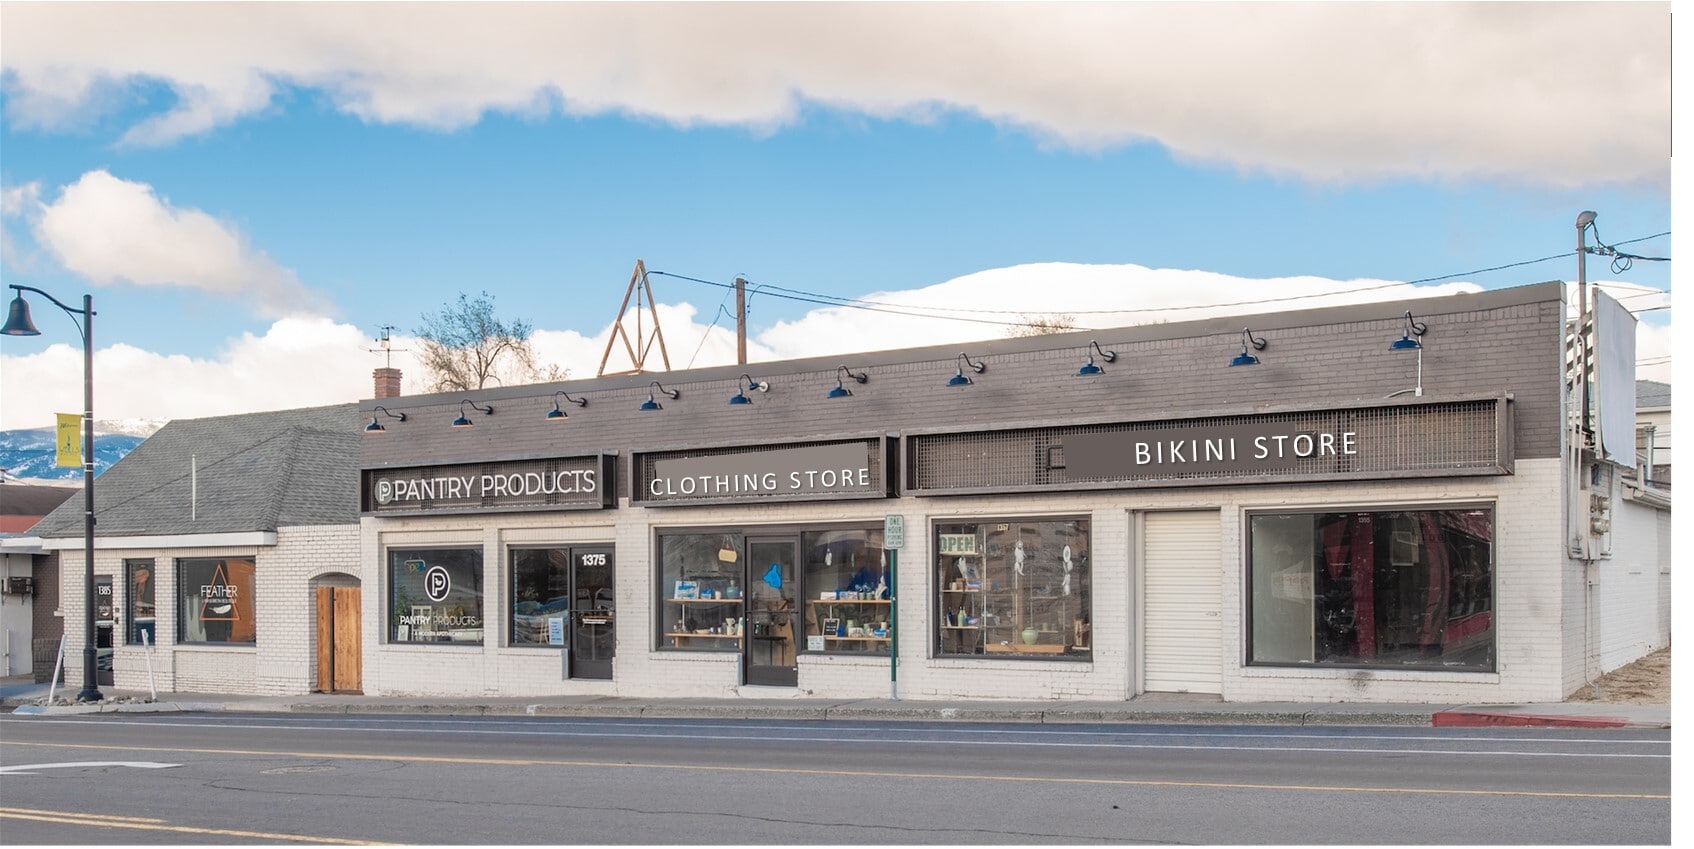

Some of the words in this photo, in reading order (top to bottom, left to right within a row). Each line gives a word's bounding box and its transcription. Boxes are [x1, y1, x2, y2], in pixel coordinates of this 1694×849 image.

[394, 476, 475, 501] PANTRY
[481, 469, 596, 498] PRODUCTS
[890, 517, 900, 525] ONE
[888, 526, 901, 534] HOUR
[940, 536, 974, 552] OPEN
[581, 554, 606, 566] 1375
[98, 585, 111, 595] 1385
[200, 585, 238, 598] FEATHER
[400, 616, 431, 625] PANTRY
[433, 615, 476, 626] PRODUCTS
